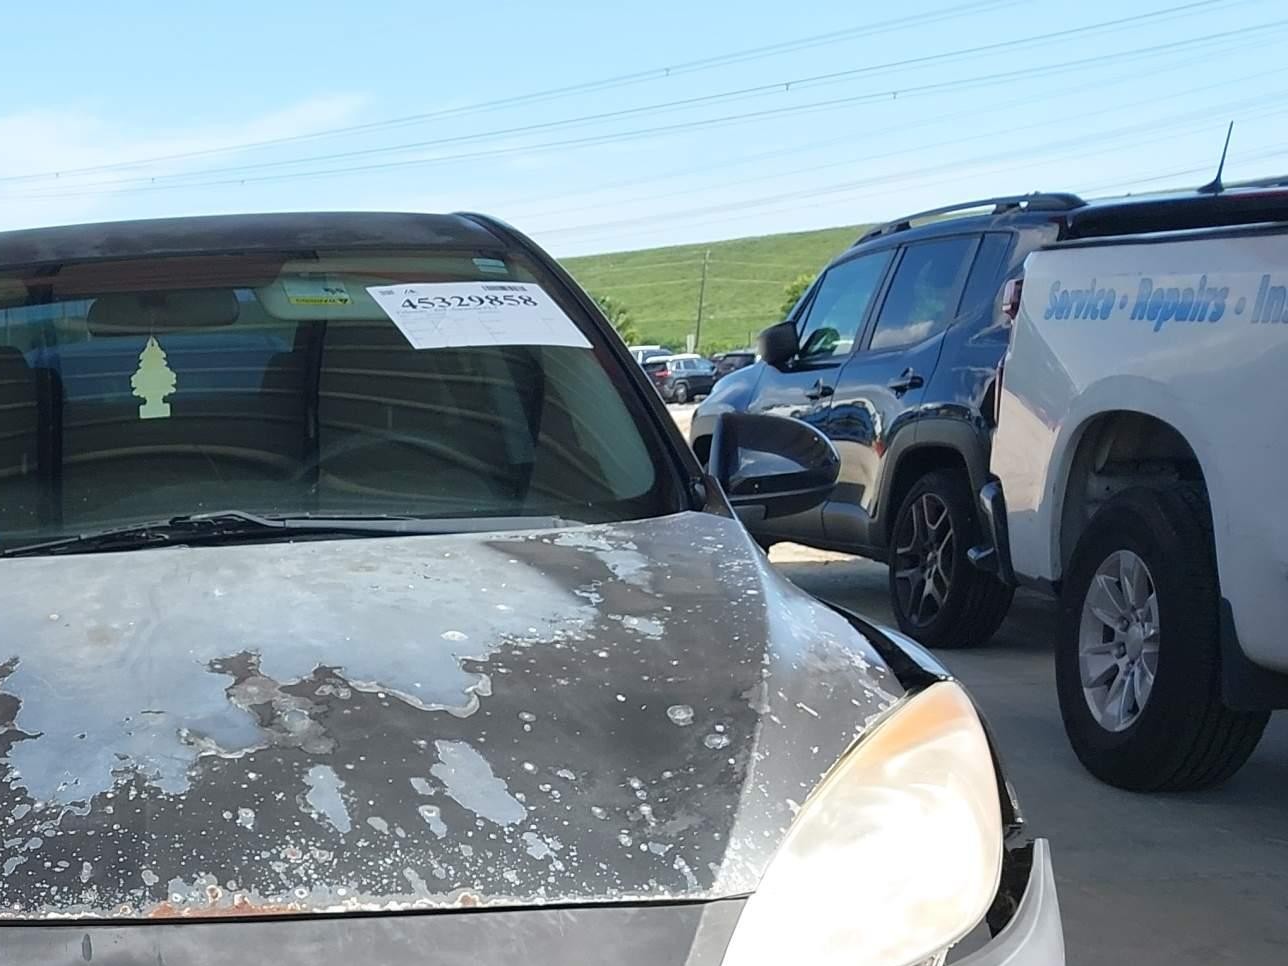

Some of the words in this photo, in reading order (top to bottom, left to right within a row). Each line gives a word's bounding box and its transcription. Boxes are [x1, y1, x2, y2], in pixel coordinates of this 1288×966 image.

[401, 295, 538, 309] 45329858
[1043, 278, 1116, 320] Service
[1130, 275, 1229, 332] Repairs
